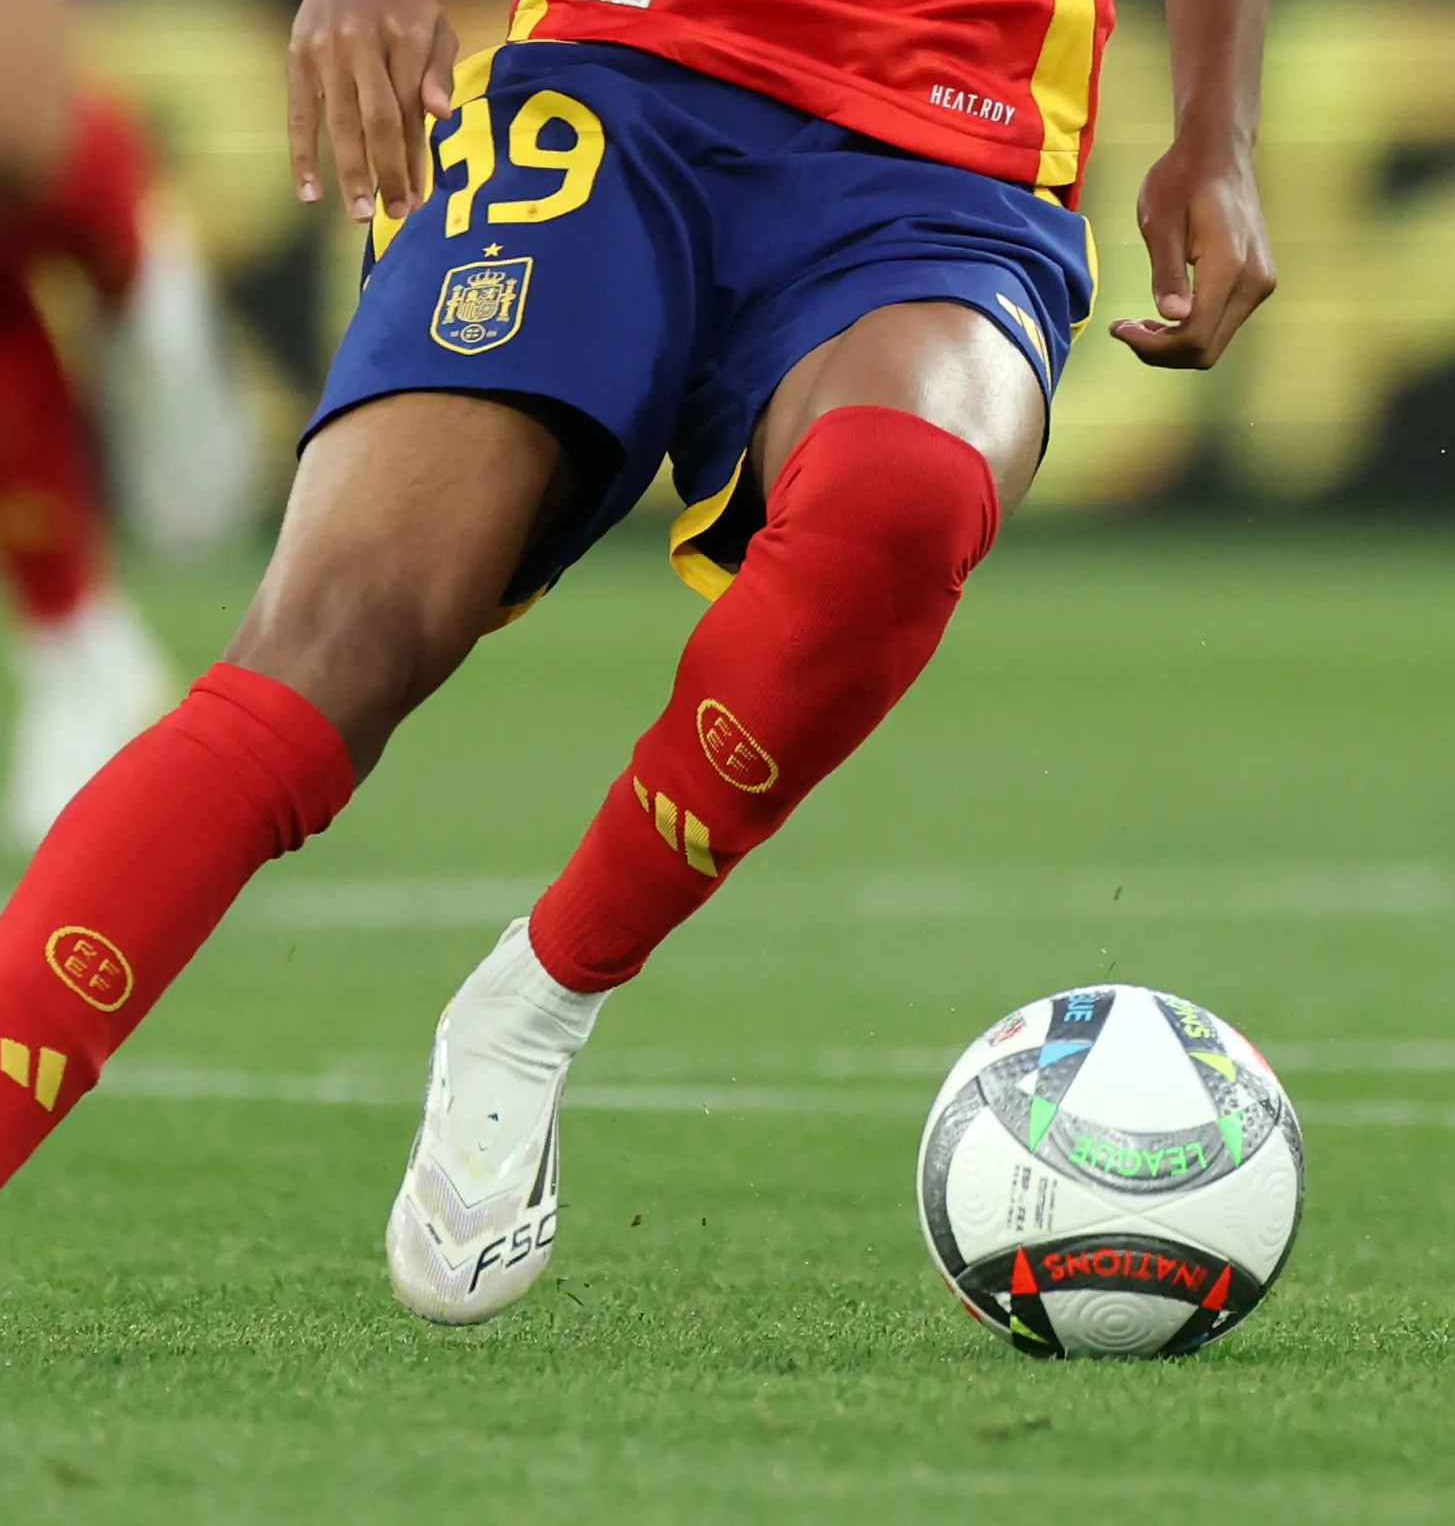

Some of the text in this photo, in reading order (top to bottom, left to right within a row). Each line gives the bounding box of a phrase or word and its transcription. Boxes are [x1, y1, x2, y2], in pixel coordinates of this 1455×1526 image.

[929, 84, 1016, 126] HEAT.RDY
[438, 89, 606, 239] 19
[1067, 1133, 1210, 1178] LEAGUE
[1043, 1247, 1210, 1292] NATIONS
